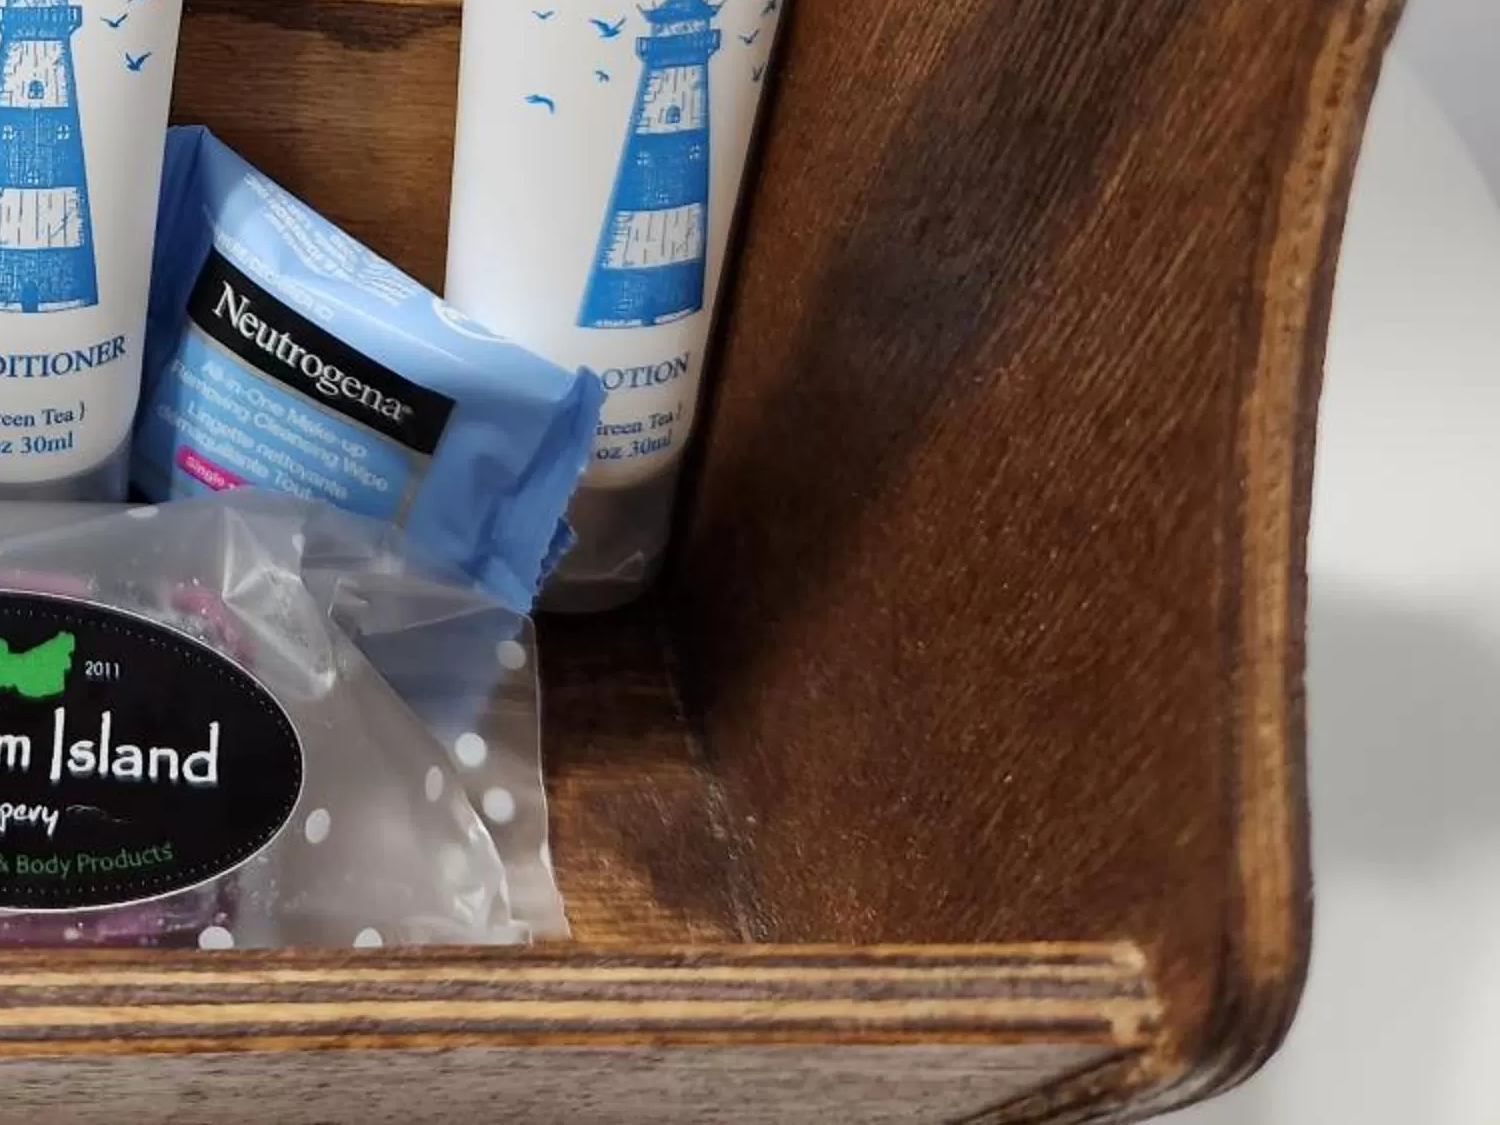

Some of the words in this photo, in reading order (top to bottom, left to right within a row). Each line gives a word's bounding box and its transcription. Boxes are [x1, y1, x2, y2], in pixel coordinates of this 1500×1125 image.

[211, 279, 407, 423] Neutrogena
[601, 350, 691, 391] OTION
[19, 430, 74, 454] 30ml
[253, 411, 339, 468] Cleansing
[596, 446, 623, 460] oz
[85, 660, 121, 679] 2011
[49, 707, 220, 787] Island
[16, 852, 71, 880] Body
[77, 841, 174, 874] Products
